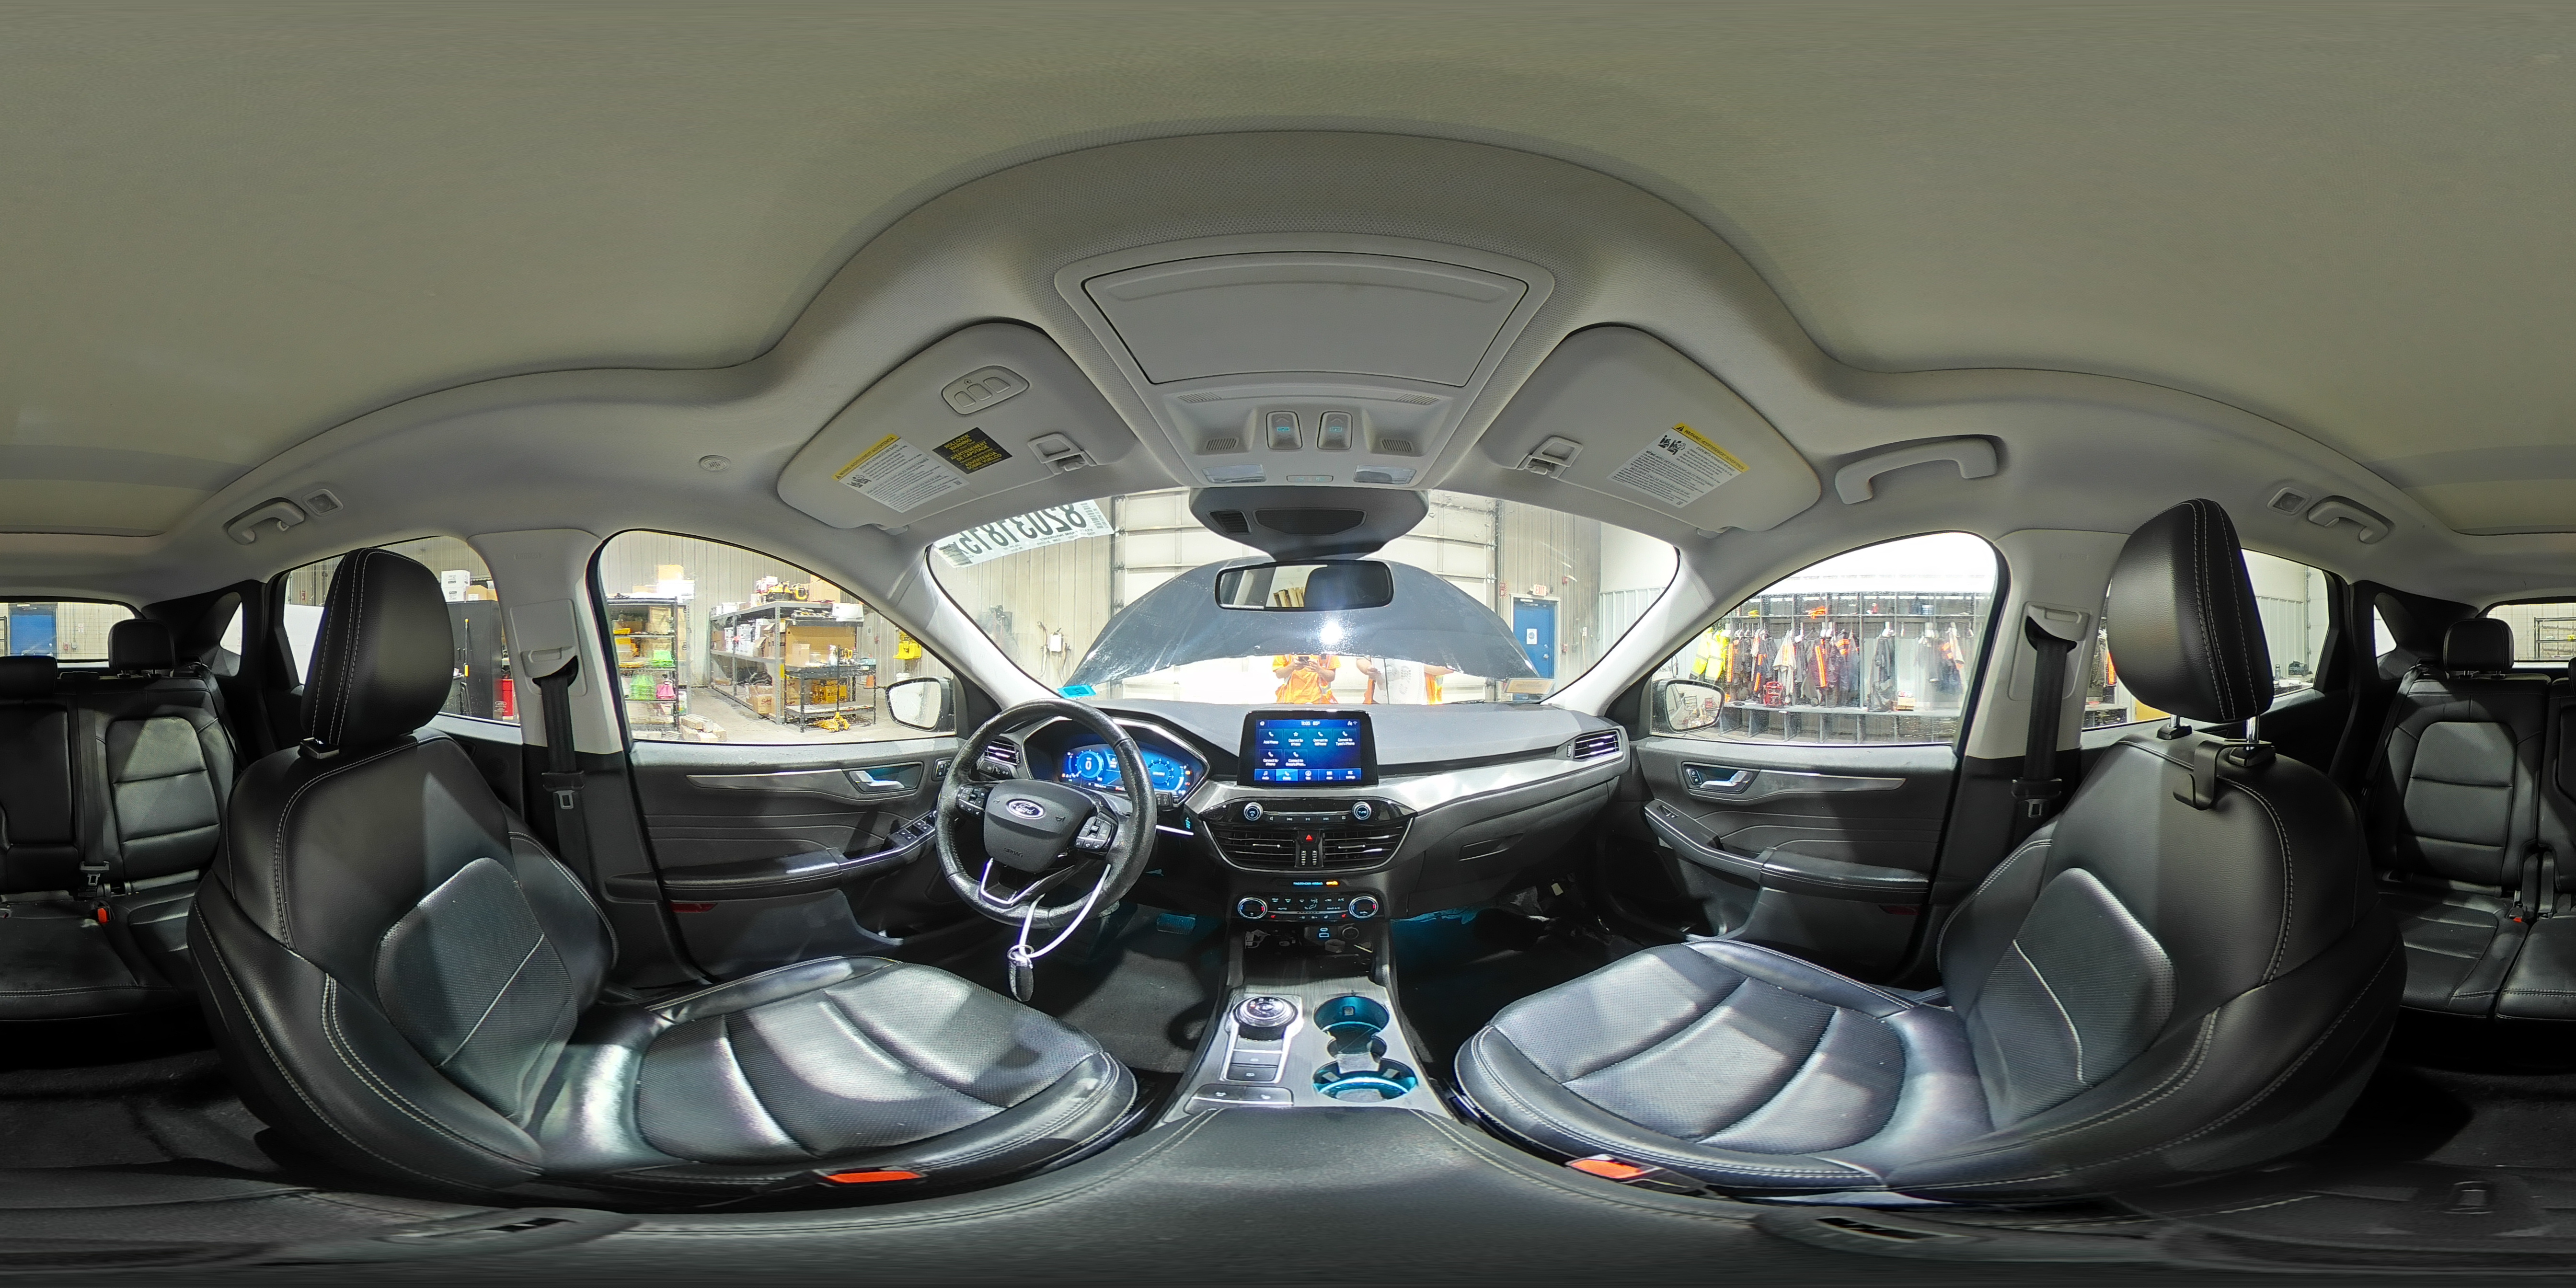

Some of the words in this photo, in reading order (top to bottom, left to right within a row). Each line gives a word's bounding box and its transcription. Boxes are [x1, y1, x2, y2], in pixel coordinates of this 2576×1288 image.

[943, 434, 971, 448] ROLLOVER
[948, 437, 973, 450] WARNING
[949, 440, 988, 460] AVERTISSEMENT
[962, 444, 989, 458] CAPOTAGE
[964, 451, 997, 466] ADVERTENCIA
[981, 453, 1003, 463] VUELCO
[1535, 585, 1544, 595] EXIT
[1085, 760, 1092, 770] 0
[1015, 804, 1035, 814] Ford
